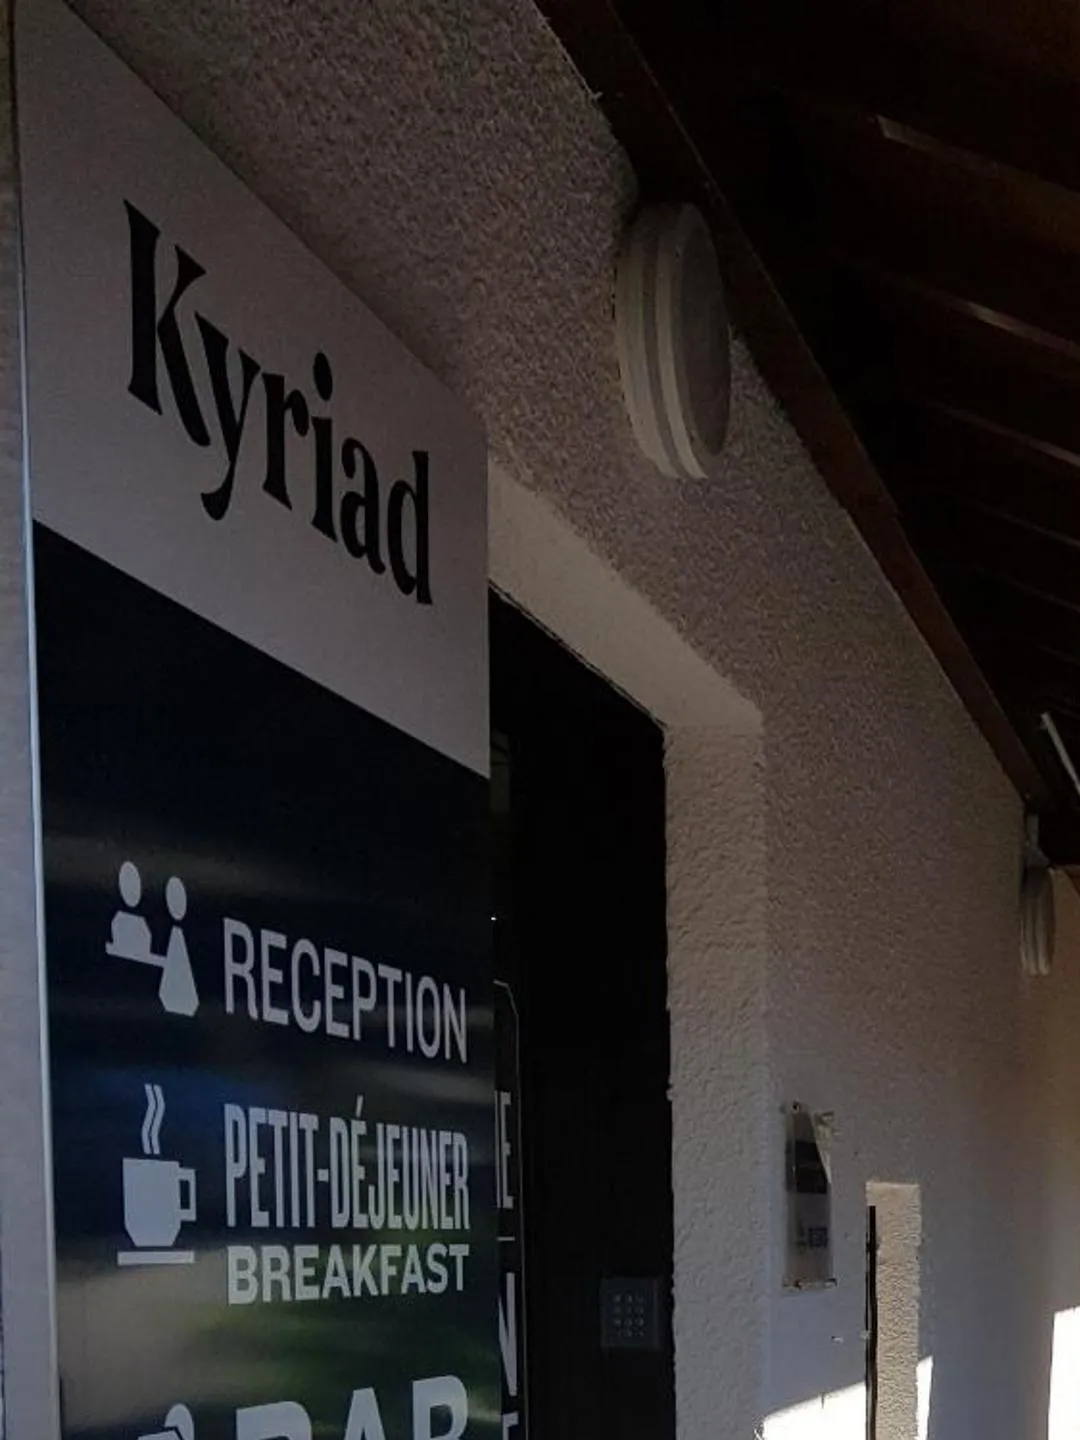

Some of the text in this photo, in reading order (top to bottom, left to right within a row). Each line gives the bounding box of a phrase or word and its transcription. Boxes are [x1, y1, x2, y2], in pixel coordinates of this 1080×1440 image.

[123, 199, 432, 604] Kyriad
[223, 917, 467, 1064] RECEPTION
[224, 1095, 470, 1232] PETIT-DÉJEUNER
[226, 1244, 469, 1306] BREAKFAST
